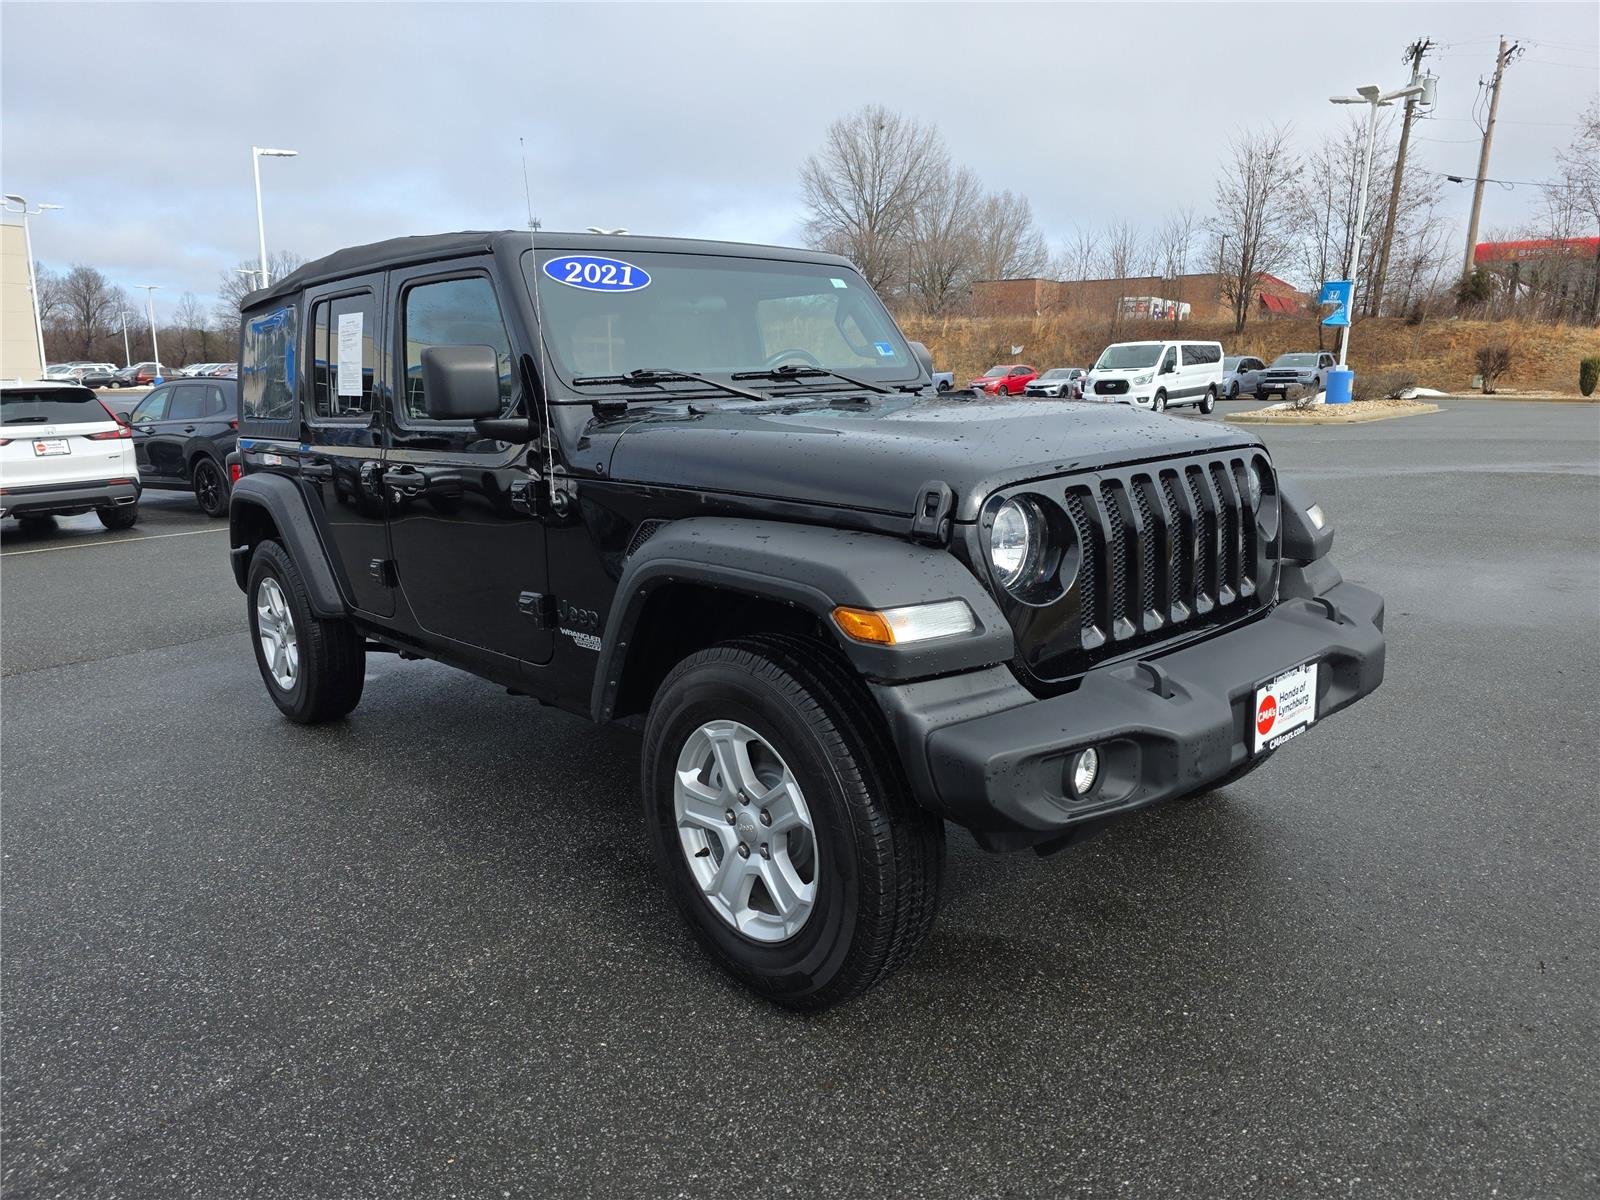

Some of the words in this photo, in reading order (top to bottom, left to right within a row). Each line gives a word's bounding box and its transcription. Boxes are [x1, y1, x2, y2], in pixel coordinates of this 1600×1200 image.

[564, 261, 634, 286] 2021
[557, 599, 600, 629] Jeep
[559, 627, 602, 643] WRANGLER
[1279, 685, 1300, 703] Honda
[1299, 680, 1307, 693] of
[1278, 693, 1310, 718] Lynchburg
[1269, 725, 1307, 750] CMAcars.com
